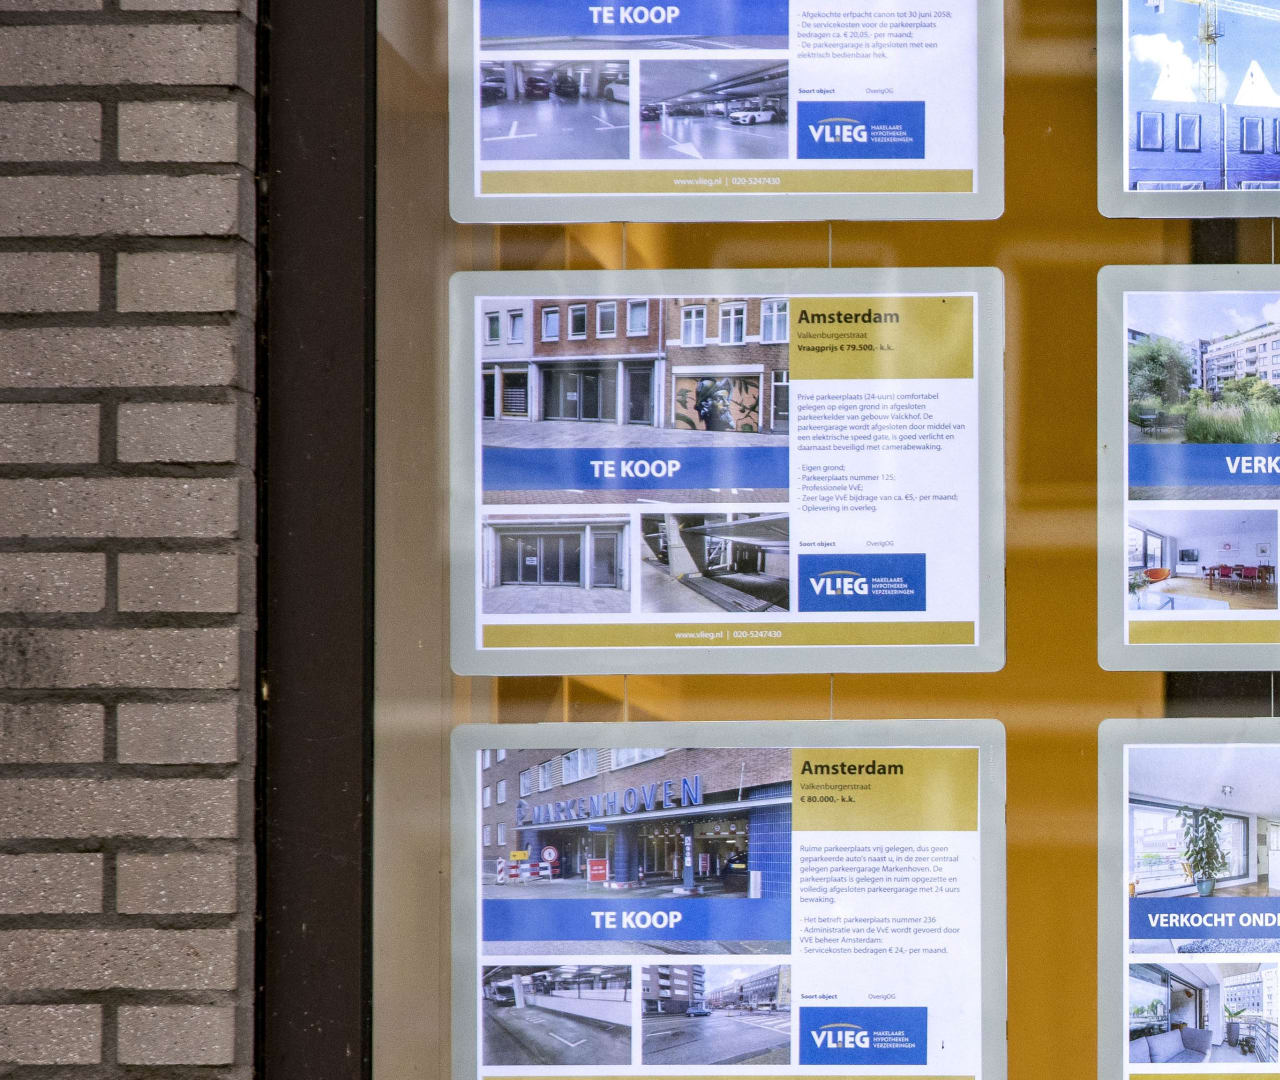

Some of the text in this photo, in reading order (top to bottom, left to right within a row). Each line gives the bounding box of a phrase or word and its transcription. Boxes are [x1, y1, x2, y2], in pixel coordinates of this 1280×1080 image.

[589, 6, 680, 24] TE KOOP
[809, 125, 867, 142] VLIEG
[798, 308, 899, 324] Amsterdam
[797, 331, 867, 340] Valkenburgerstraat
[797, 344, 838, 353] Vraagprijs
[846, 344, 878, 353] 79.500,-
[590, 460, 681, 478] TE KOOP
[810, 578, 868, 595] VLIEG
[800, 760, 904, 775] Amsterdam
[800, 783, 871, 792] Valkenburgerstraat
[807, 795, 839, 803] 80.000,-
[591, 911, 682, 929] TE KOOP
[1148, 913, 1236, 927] VERKOCHT
[811, 1031, 869, 1048] VLIEG
